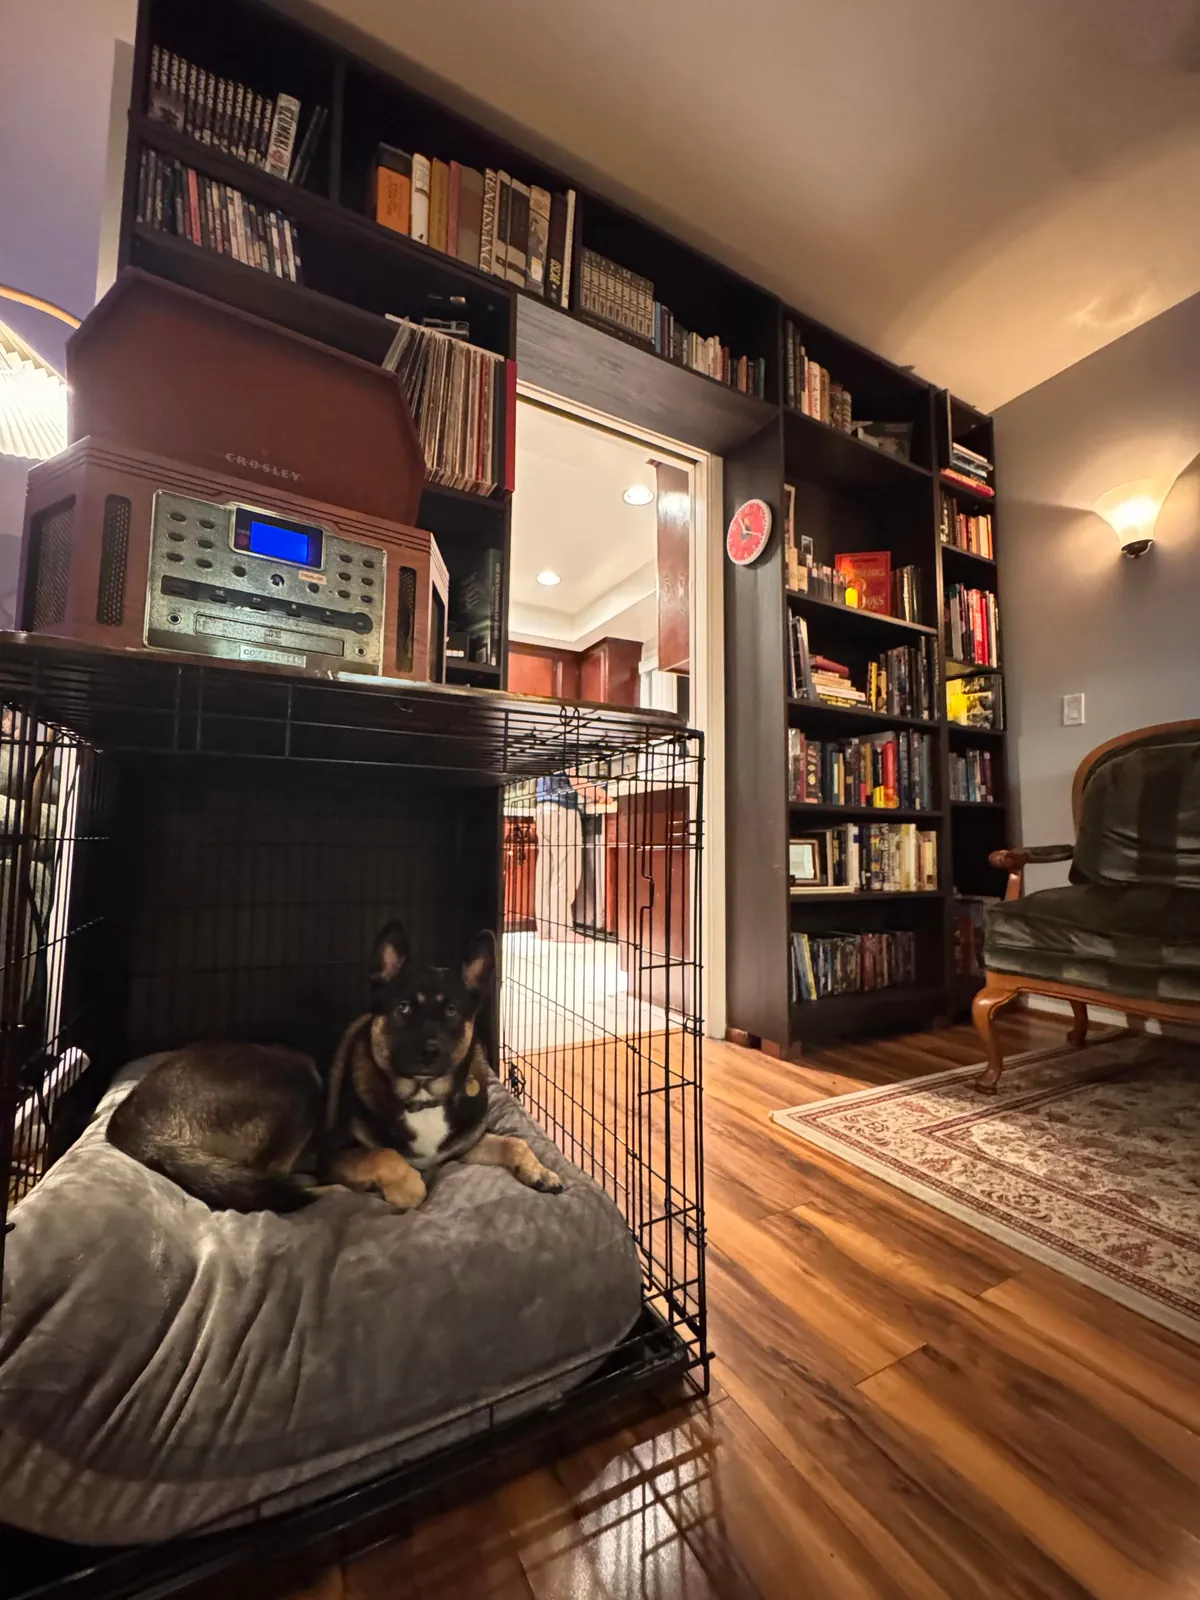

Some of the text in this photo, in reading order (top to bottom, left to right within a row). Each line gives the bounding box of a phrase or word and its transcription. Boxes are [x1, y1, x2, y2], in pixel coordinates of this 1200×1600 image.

[273, 105, 295, 152] UZUMAKI
[479, 167, 497, 273] RENAISSANCE
[225, 452, 300, 482] CROSLEY
